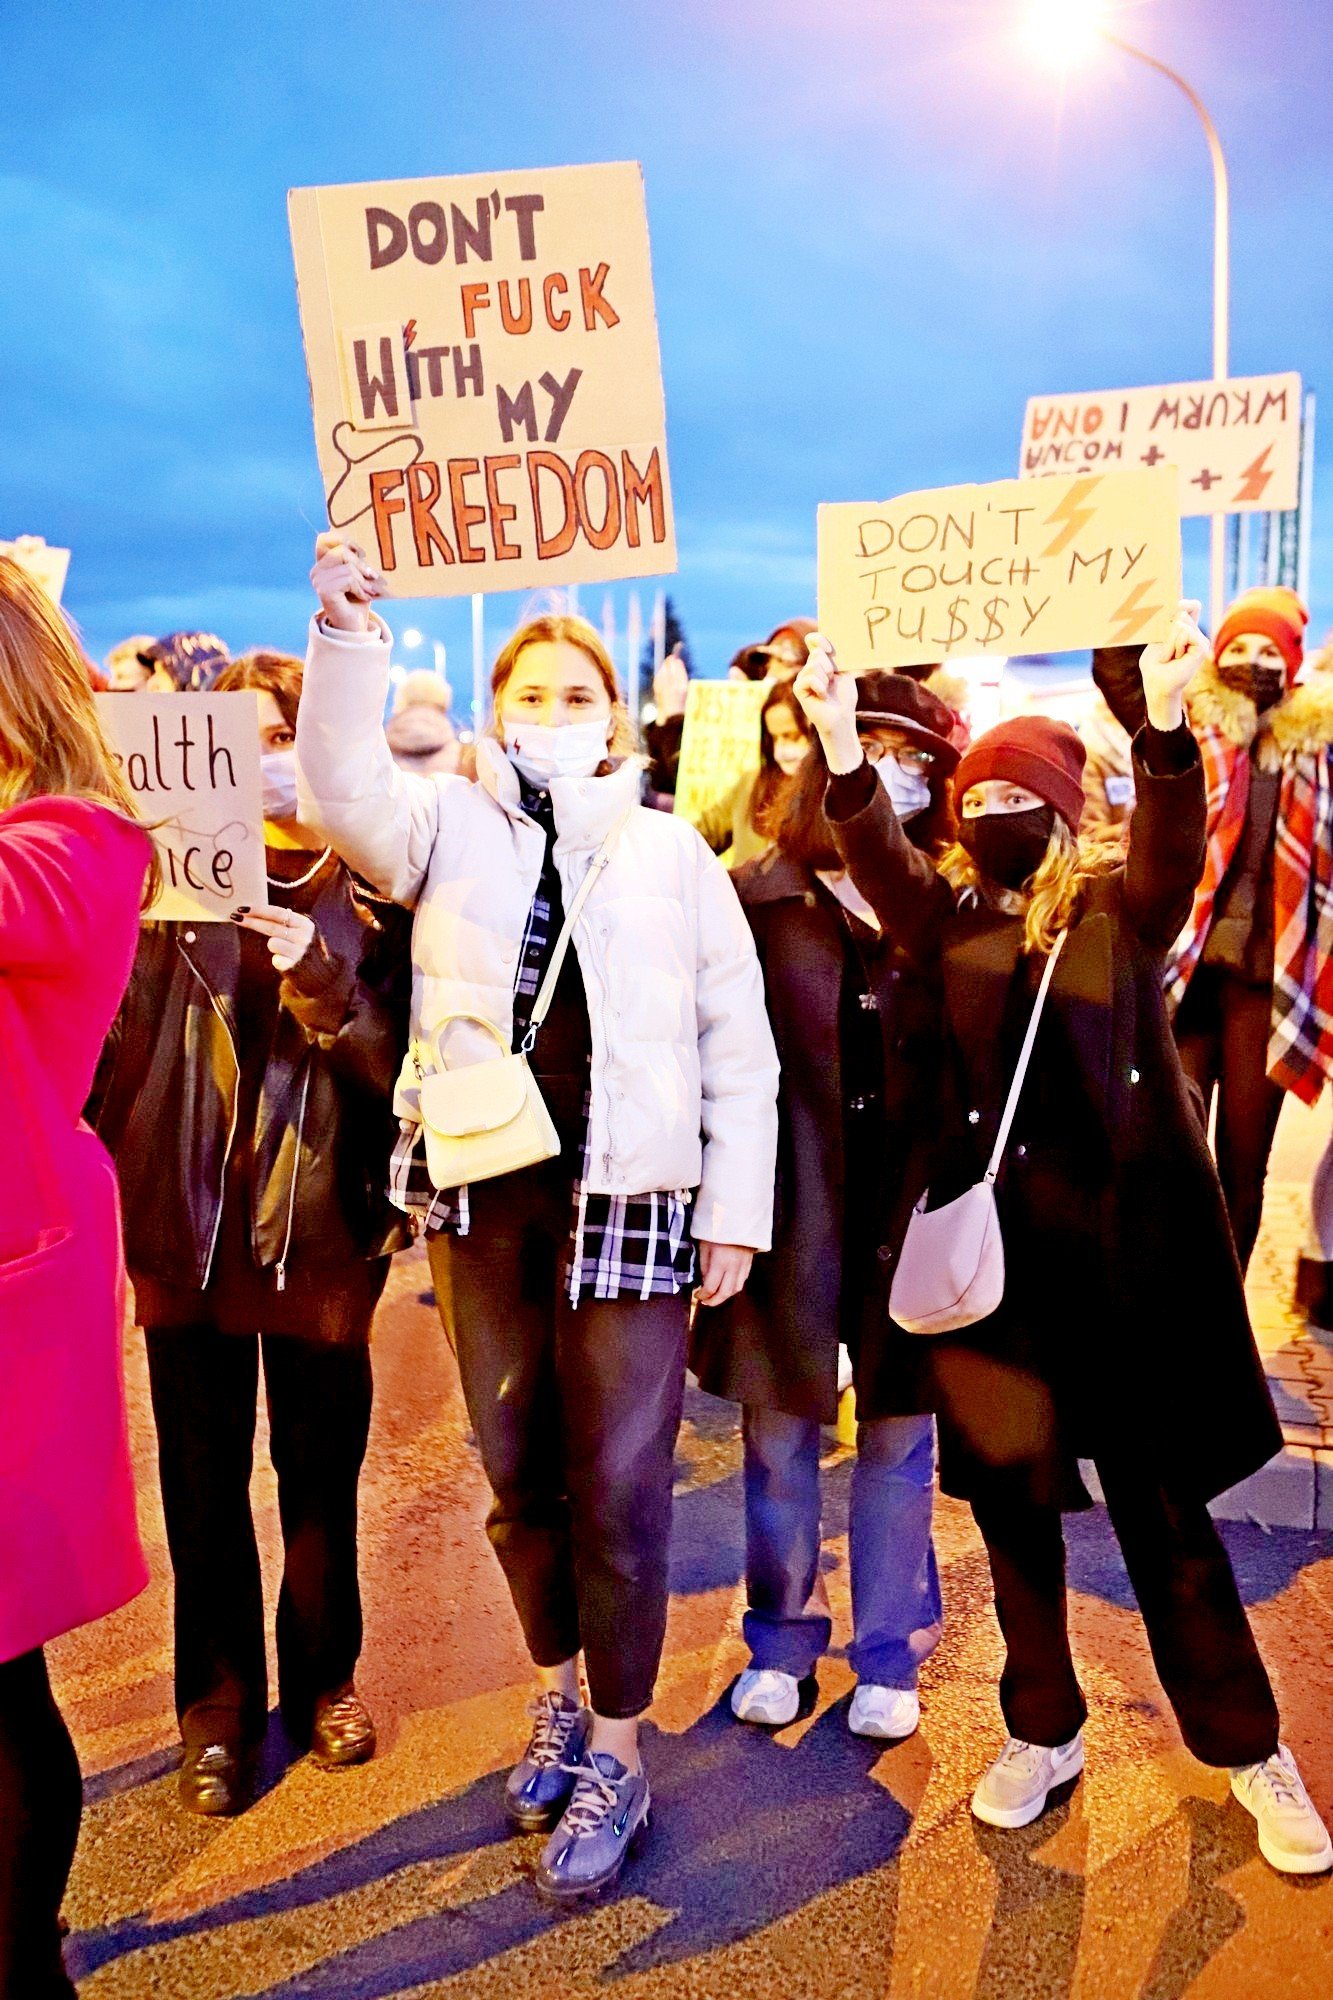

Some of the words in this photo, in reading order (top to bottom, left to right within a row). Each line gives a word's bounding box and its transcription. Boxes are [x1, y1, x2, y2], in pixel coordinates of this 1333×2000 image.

[365, 188, 544, 270] DON'T
[460, 262, 620, 338] FUCK
[496, 368, 583, 443] MY
[369, 446, 666, 571] FREEDOM
[855, 502, 1035, 558] DON'T
[858, 556, 1040, 600] TOUCH
[1068, 543, 1148, 585] MY
[863, 594, 1051, 652] PU$$Y
